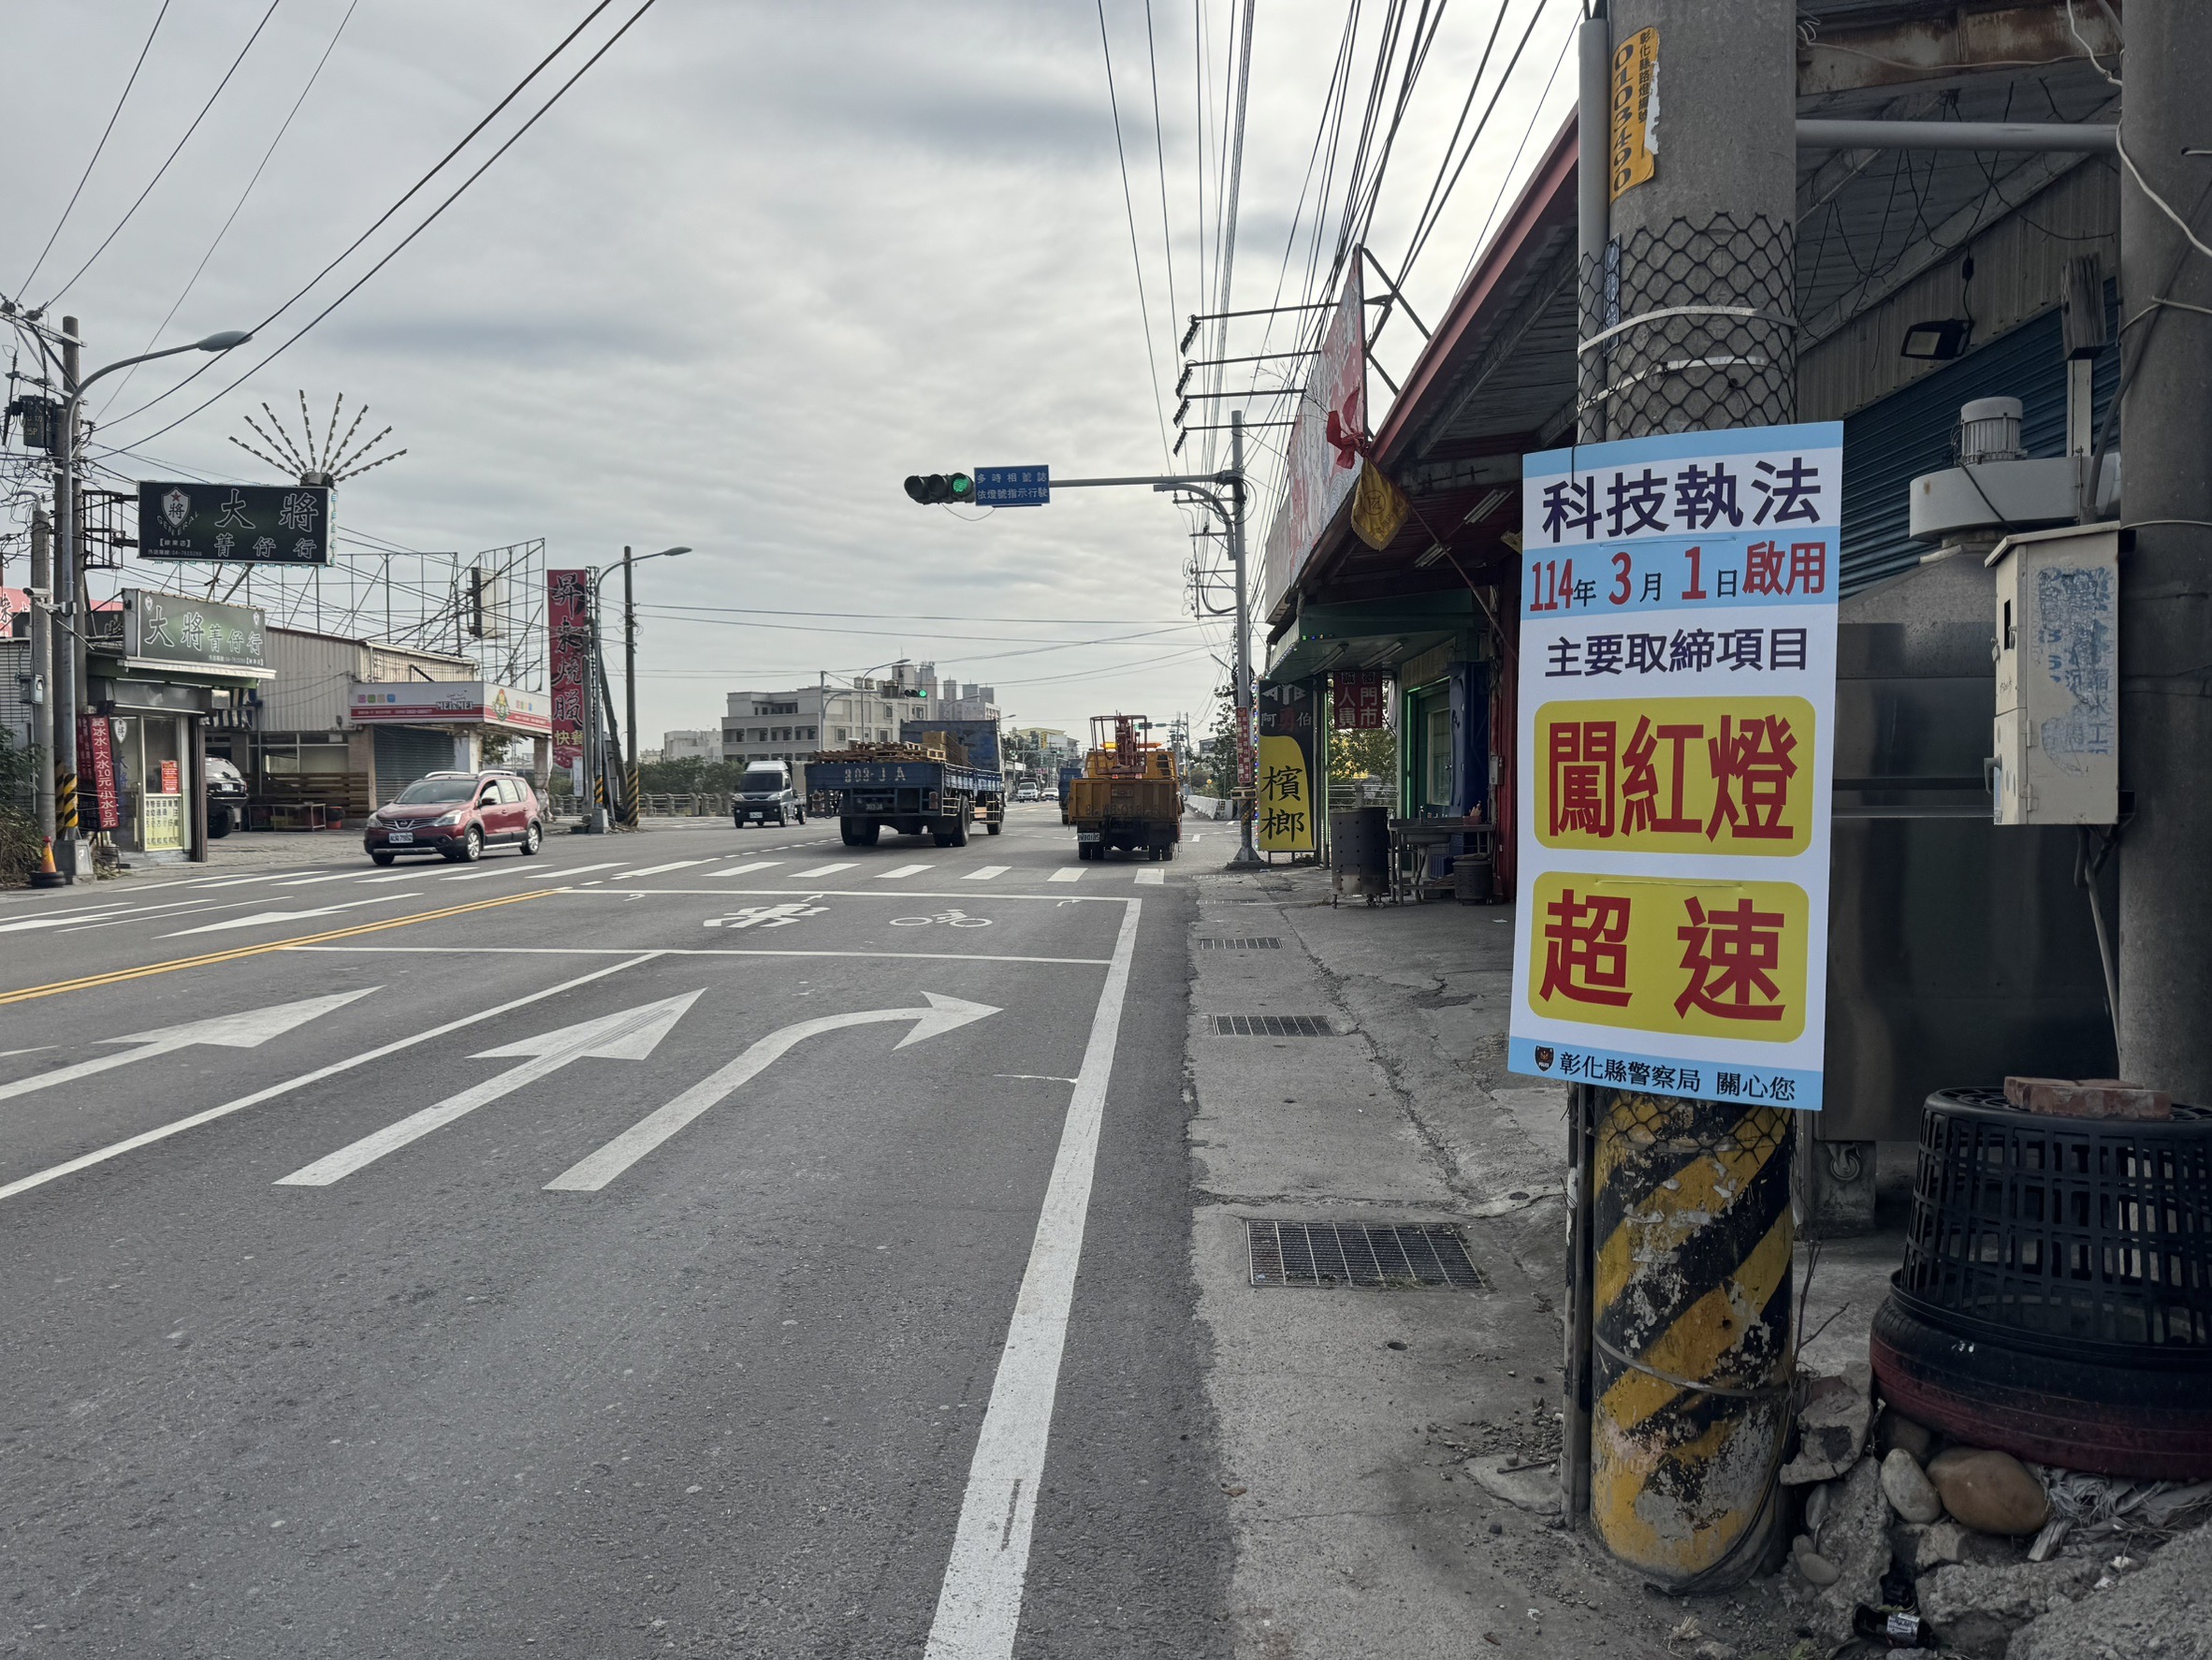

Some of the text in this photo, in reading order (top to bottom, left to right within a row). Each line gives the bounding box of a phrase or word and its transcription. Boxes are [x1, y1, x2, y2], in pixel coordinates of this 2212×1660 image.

[1613, 43, 1634, 193] 0103490
[977, 471, 1047, 485] 多時相號誌
[977, 487, 1048, 500] 依燈號指示行駛
[1542, 457, 1822, 544] 科技執法
[156, 511, 199, 536] GENERAL
[214, 488, 319, 533] 大將
[214, 532, 317, 560] 菁仔行
[1545, 627, 1808, 679] 主要取締項目
[1549, 713, 1798, 842] 闖紅燈
[1260, 765, 1304, 843] 檳榔
[1538, 887, 1787, 1022] 超速
[1559, 1051, 1796, 1101] 彰化縣警察局 關心您
